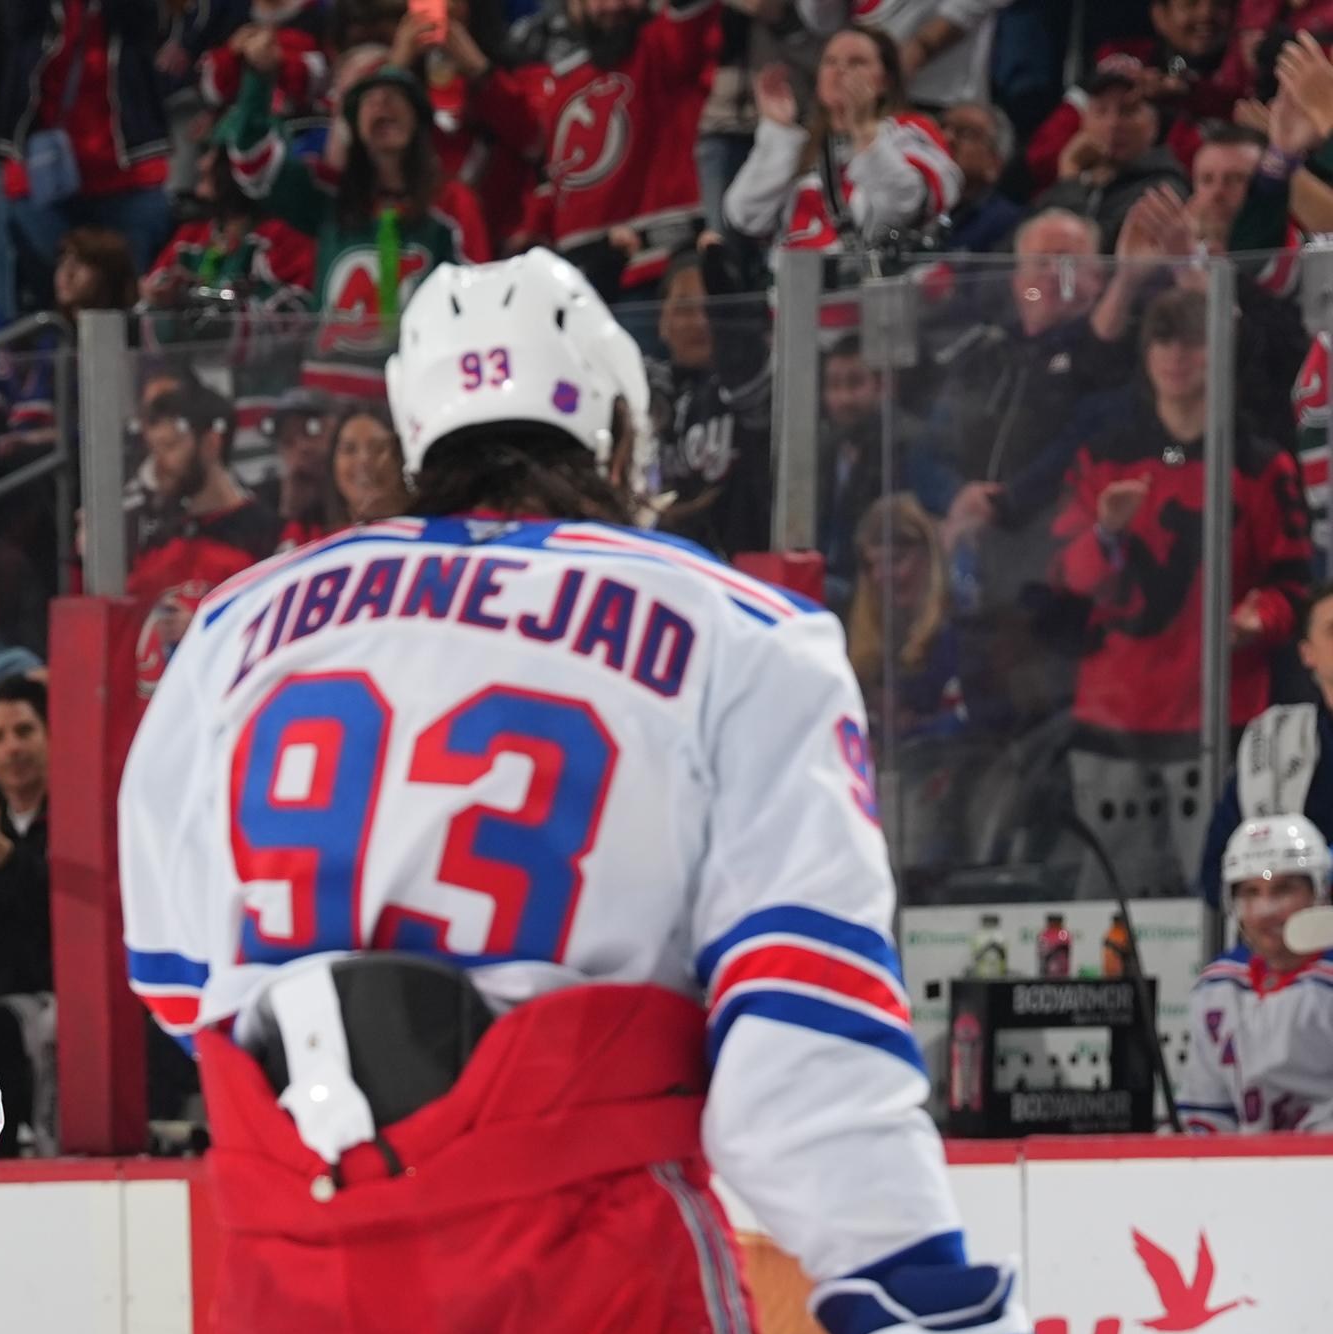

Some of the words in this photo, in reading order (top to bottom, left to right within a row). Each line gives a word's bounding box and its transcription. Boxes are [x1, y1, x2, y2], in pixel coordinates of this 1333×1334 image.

[459, 347, 511, 391] 93
[226, 554, 696, 701] ZIBANEJAD
[230, 667, 620, 968] 93
